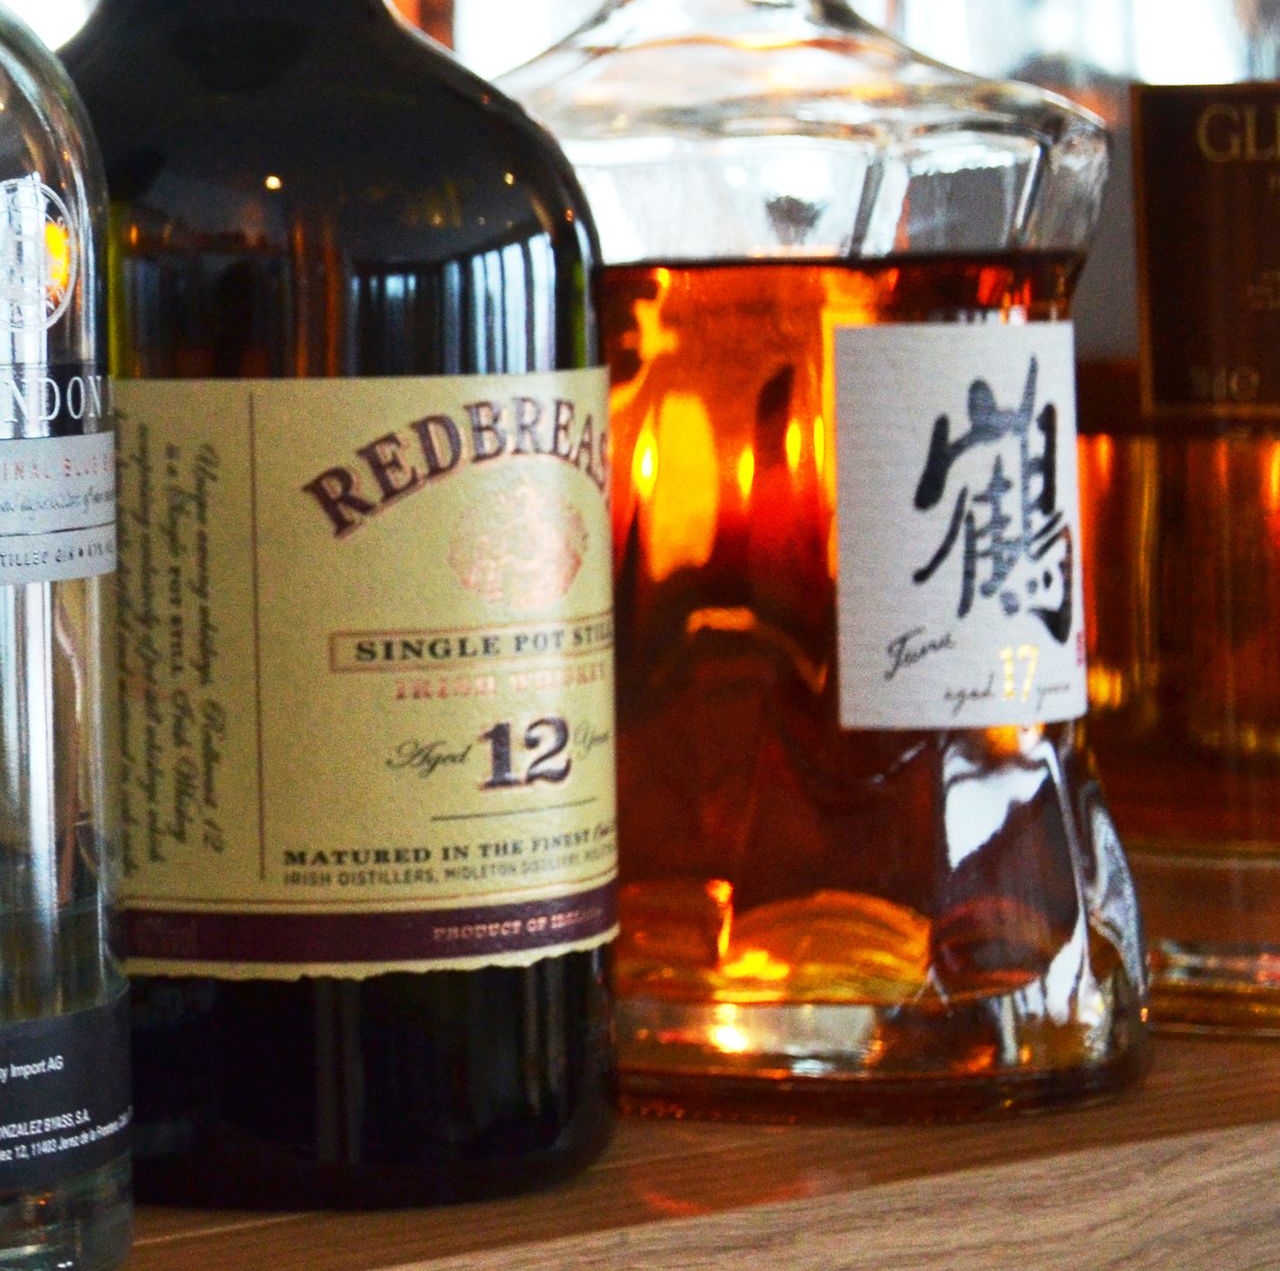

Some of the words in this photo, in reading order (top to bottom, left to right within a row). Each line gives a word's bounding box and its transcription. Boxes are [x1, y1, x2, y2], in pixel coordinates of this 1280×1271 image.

[1197, 102, 1280, 163] GL
[355, 634, 500, 662] SINGLE
[514, 630, 565, 653] POT
[999, 643, 1039, 702] 17
[385, 738, 473, 777] Aged
[479, 716, 572, 791] 12
[282, 846, 432, 867] MATURED
[442, 844, 470, 862] IN
[478, 839, 524, 858] THE
[10, 1060, 46, 1080] Import
[47, 1055, 65, 1072] AG
